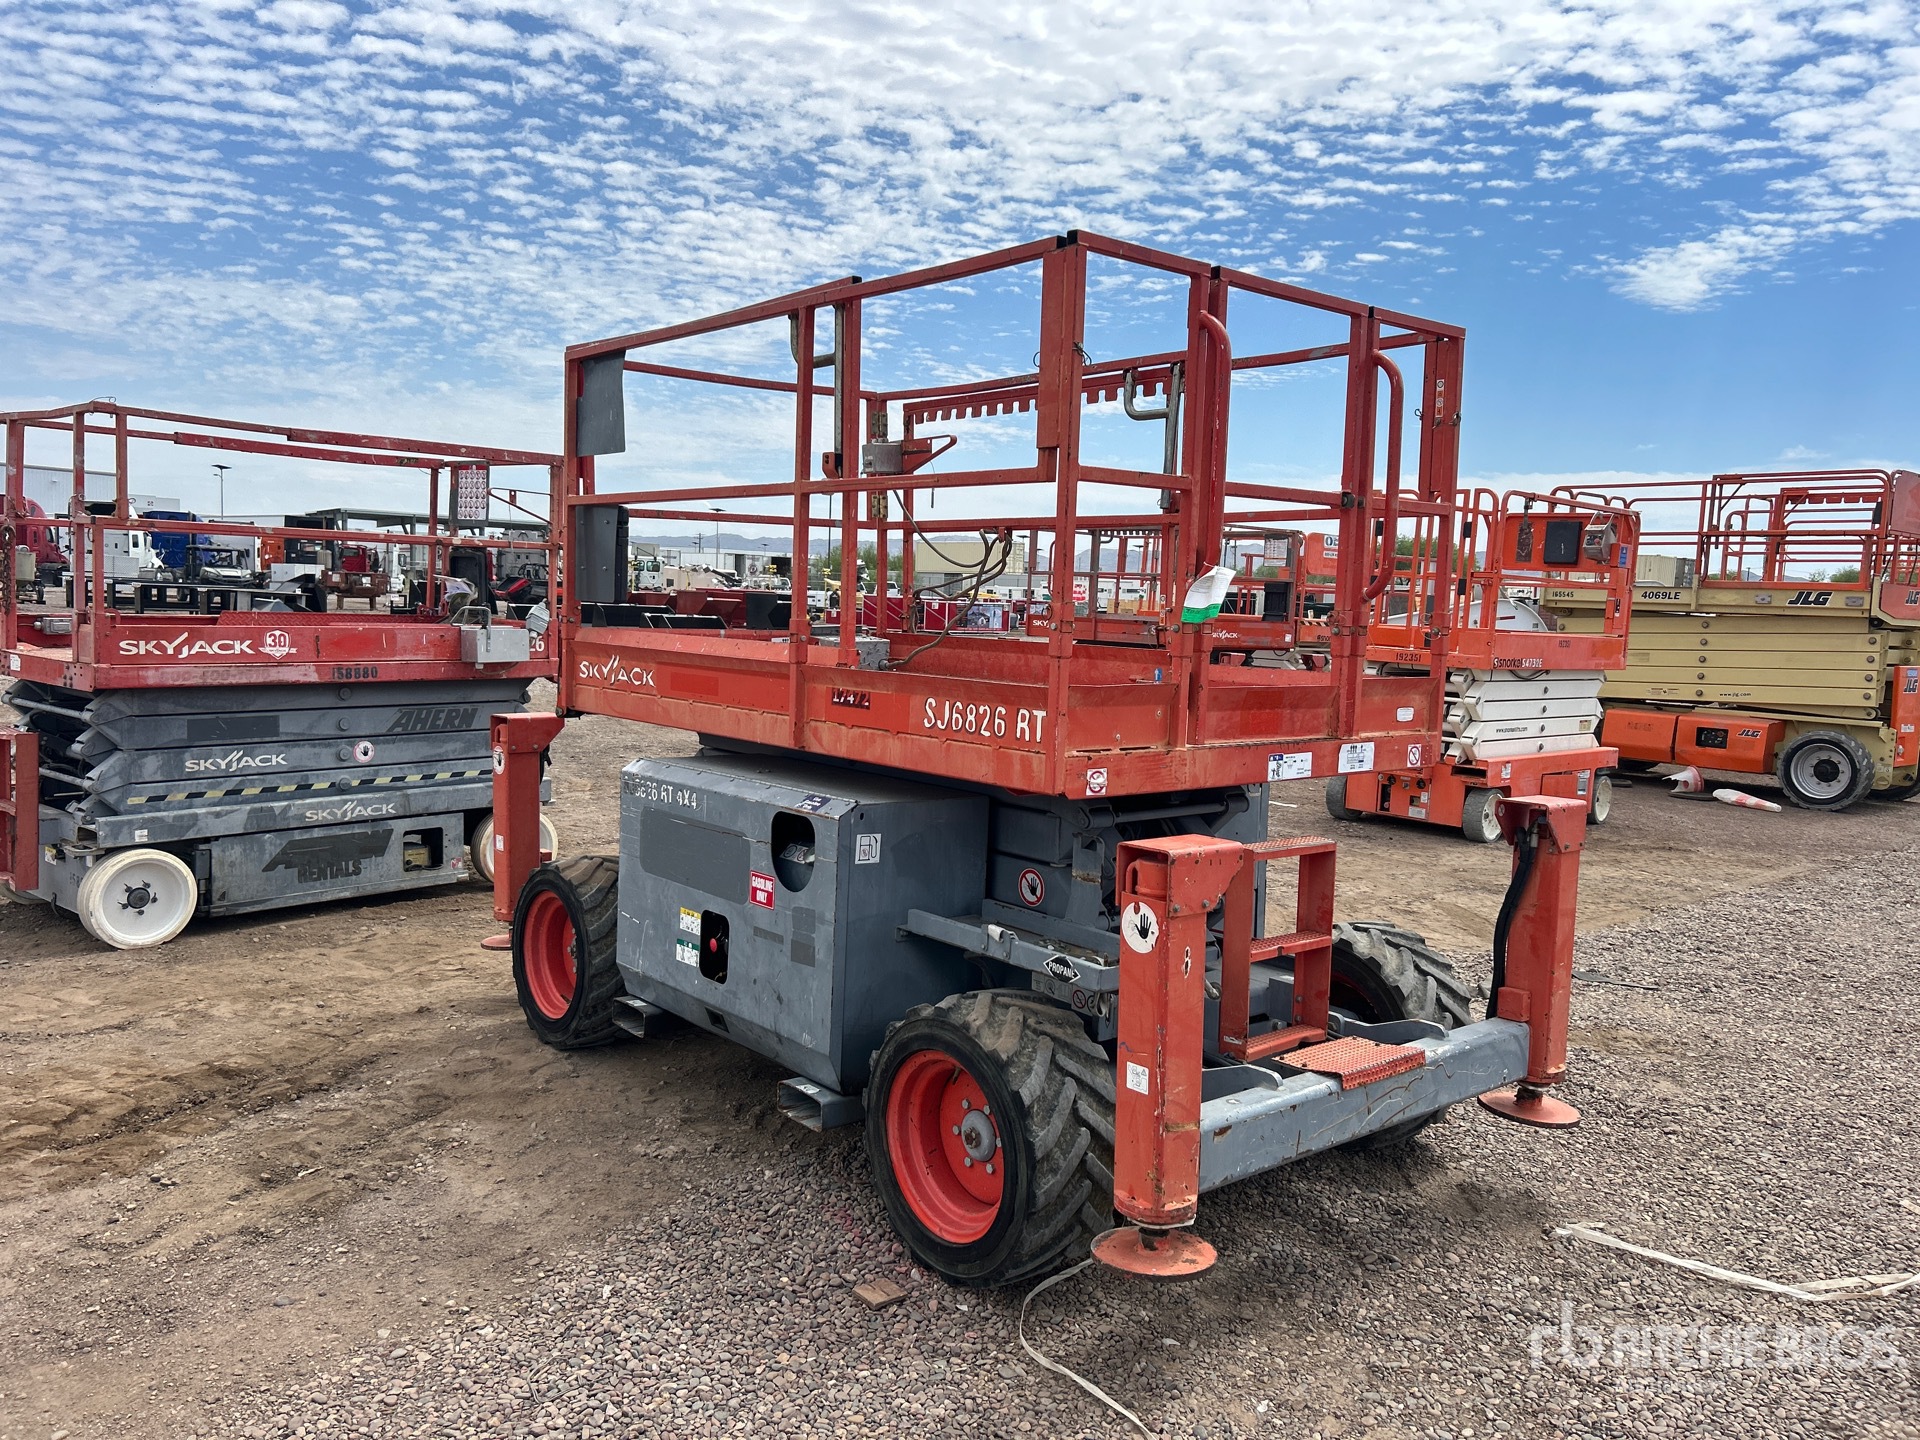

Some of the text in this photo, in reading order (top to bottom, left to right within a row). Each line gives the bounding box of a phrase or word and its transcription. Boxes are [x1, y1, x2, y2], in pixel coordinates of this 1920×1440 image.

[1552, 590, 1574, 598] 165545
[1641, 591, 1682, 600] 4069LE
[1786, 590, 1834, 606] JLG
[119, 631, 256, 659] SKYJACK
[268, 632, 287, 648] 30
[1396, 652, 1422, 663] 192351
[579, 654, 656, 687] SKYJACK
[1903, 678, 1918, 693] JLG
[832, 687, 869, 706] 17472
[386, 706, 479, 733] AHERN
[924, 696, 1047, 743] SJ6826 RT
[1737, 728, 1762, 739] JLG
[185, 750, 288, 772] SKYJACK
[660, 783, 674, 804] RT
[305, 800, 397, 822] SKYJACK
[298, 859, 362, 884] RENTALS
[1048, 961, 1076, 978] PROPANE
